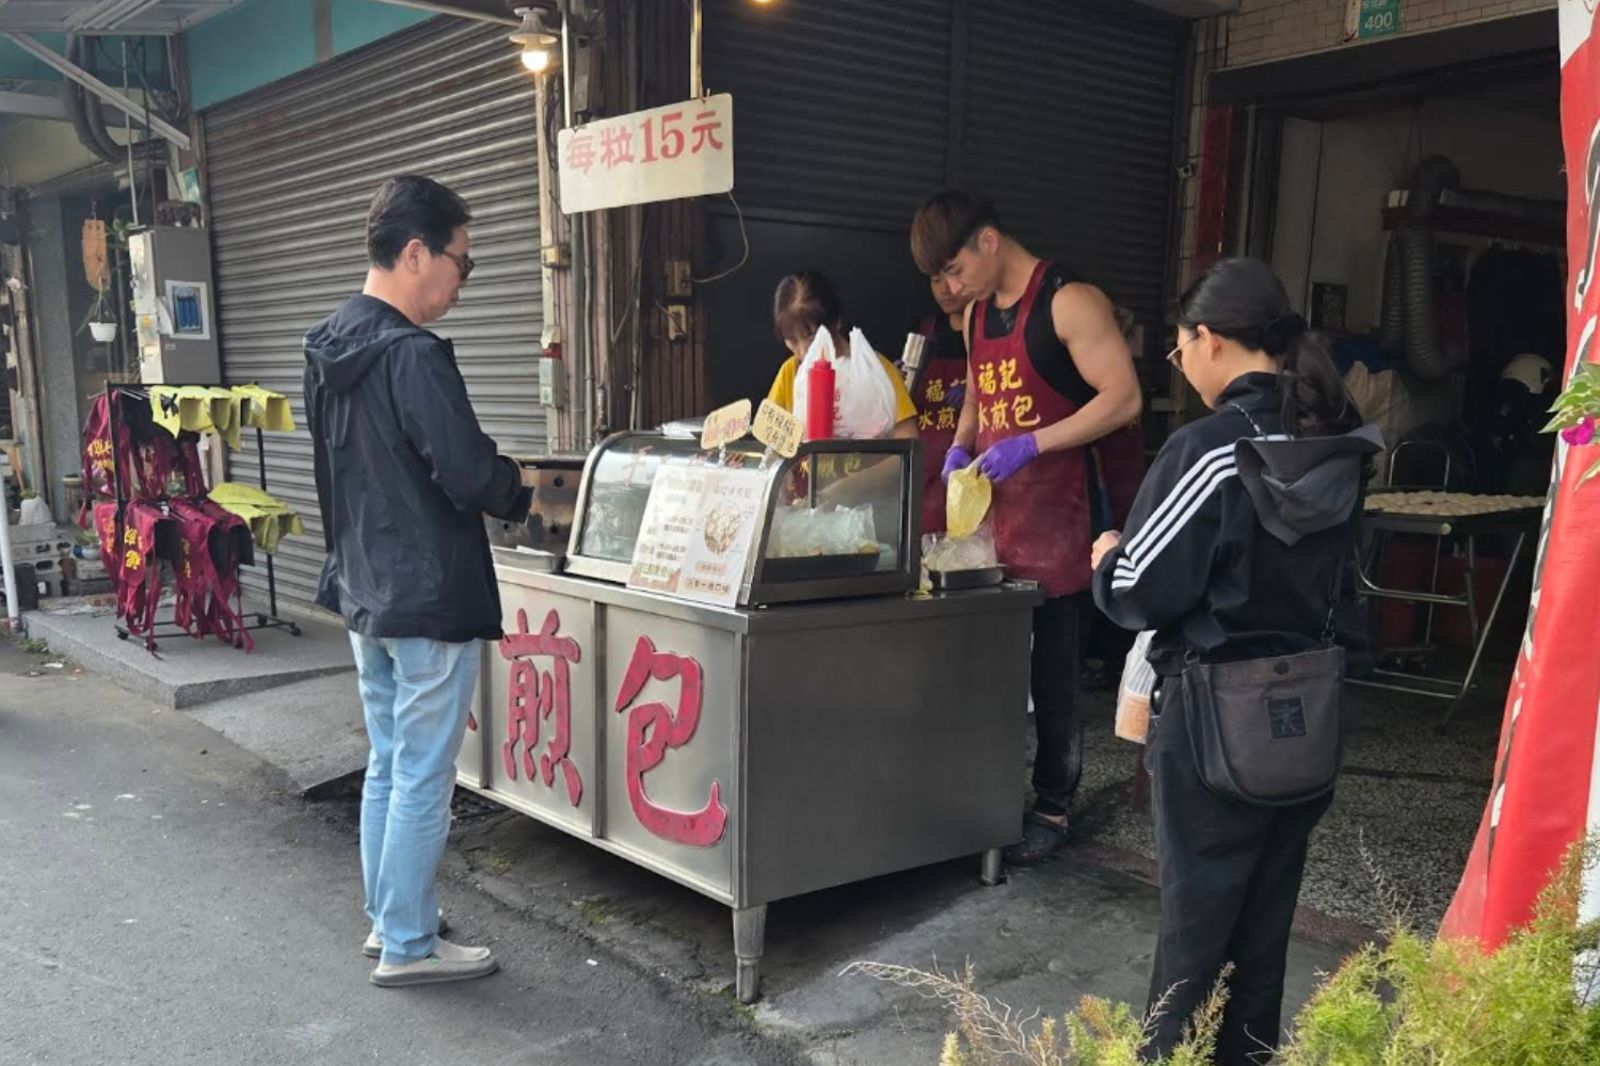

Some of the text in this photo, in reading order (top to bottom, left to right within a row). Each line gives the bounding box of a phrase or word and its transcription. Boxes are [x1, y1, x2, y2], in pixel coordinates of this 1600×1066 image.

[1364, 11, 1393, 30] 400
[566, 110, 723, 175] 每粒15元
[978, 358, 1023, 395] 福記
[467, 607, 728, 848] 煎包
